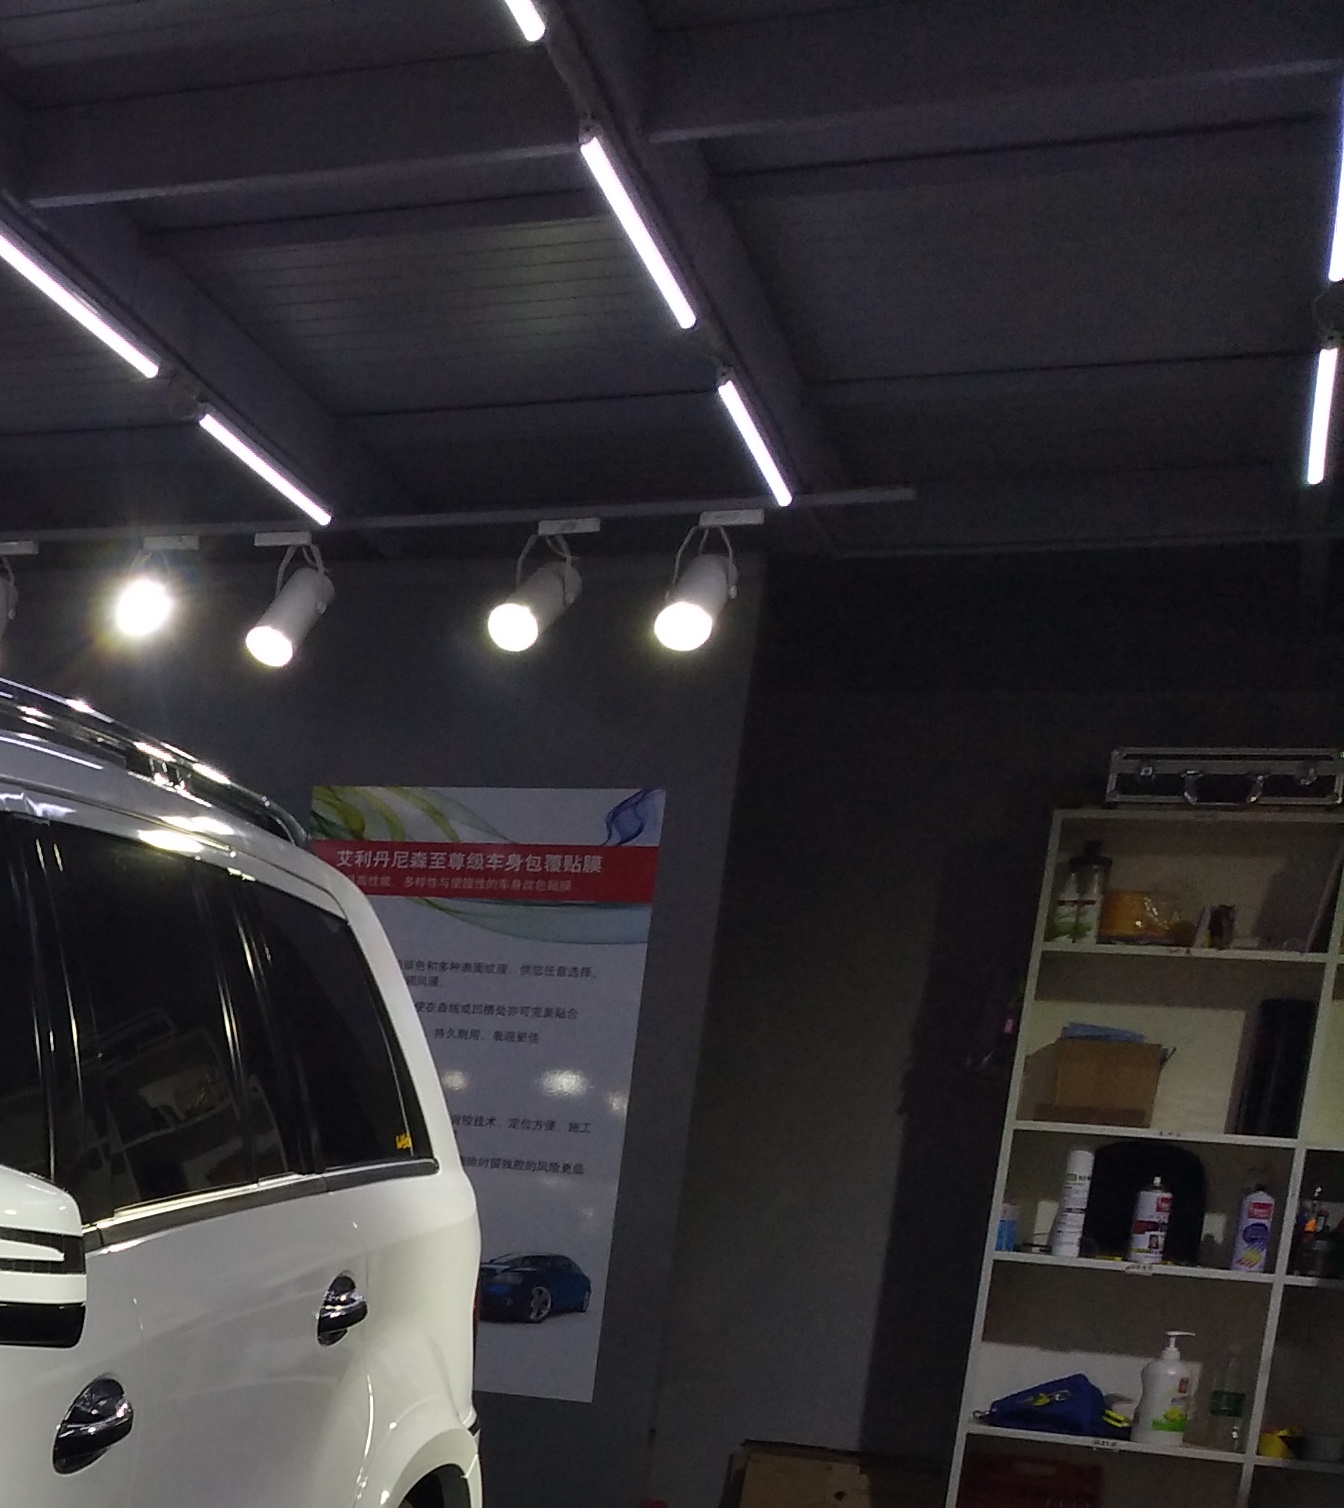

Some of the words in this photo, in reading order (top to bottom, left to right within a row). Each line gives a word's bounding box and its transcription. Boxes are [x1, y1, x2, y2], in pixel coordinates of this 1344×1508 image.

[336, 850, 603, 873] 艾利丹尼森至尊级车身包覆贴膜
